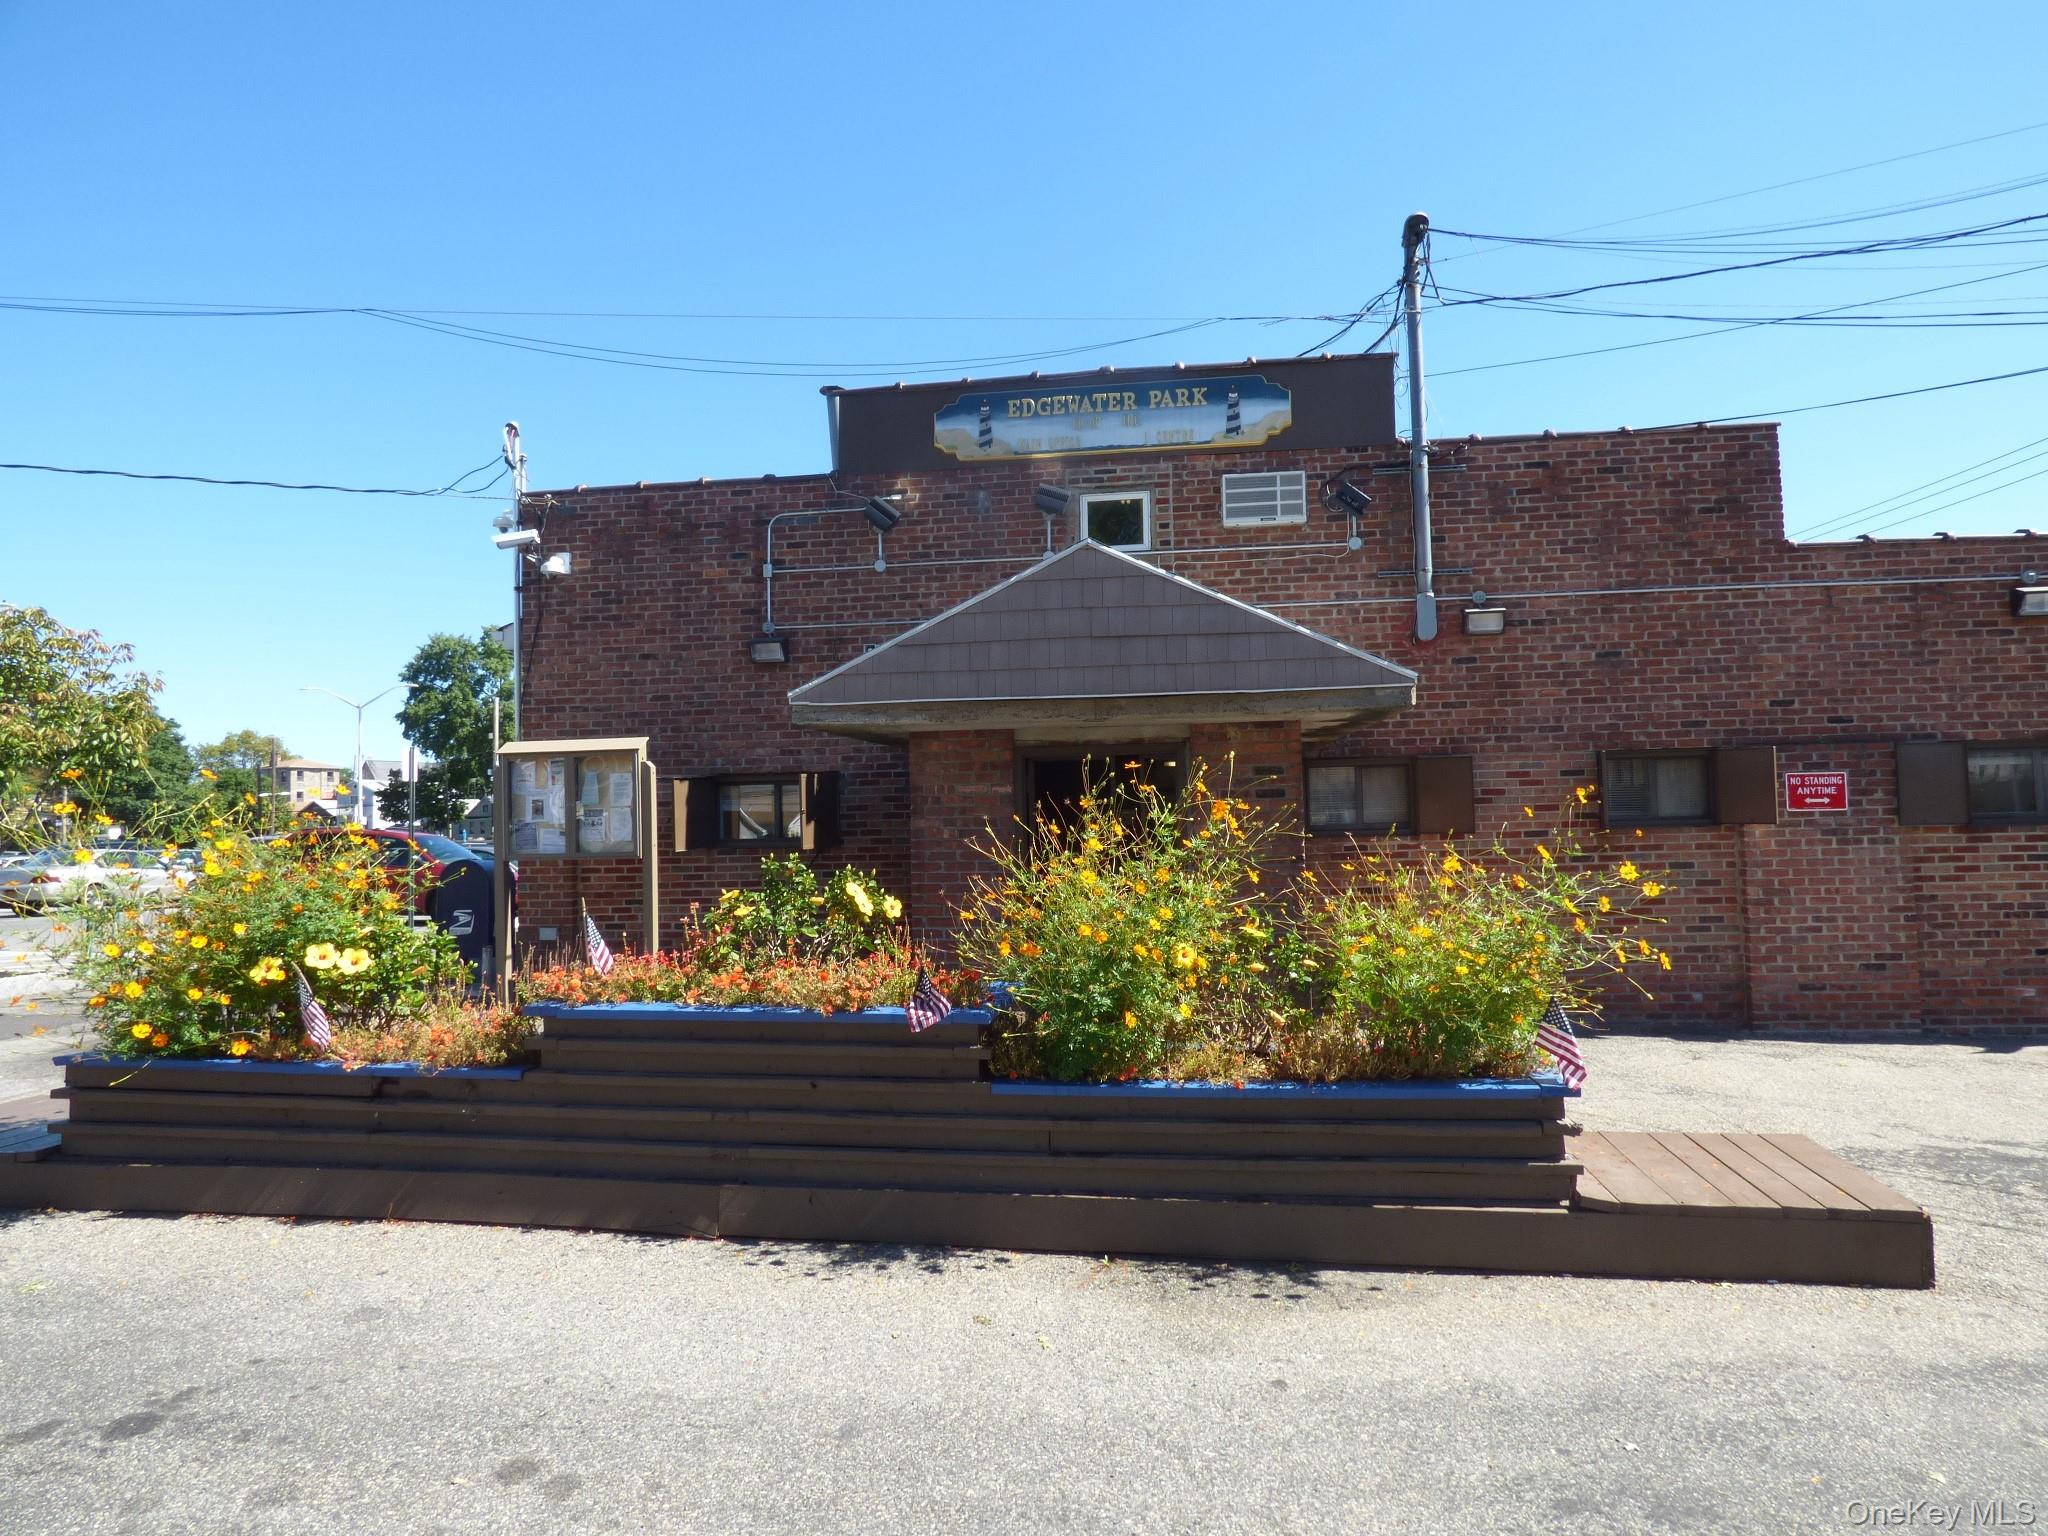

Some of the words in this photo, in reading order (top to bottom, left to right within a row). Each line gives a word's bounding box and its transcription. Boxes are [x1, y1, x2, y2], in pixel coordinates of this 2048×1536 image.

[1007, 392, 1137, 418] EDGEWATER
[1149, 386, 1208, 409] PARK
[1790, 777, 1801, 785] NO
[1804, 776, 1843, 785] STANDING
[1796, 786, 1838, 795] ANYTIME
